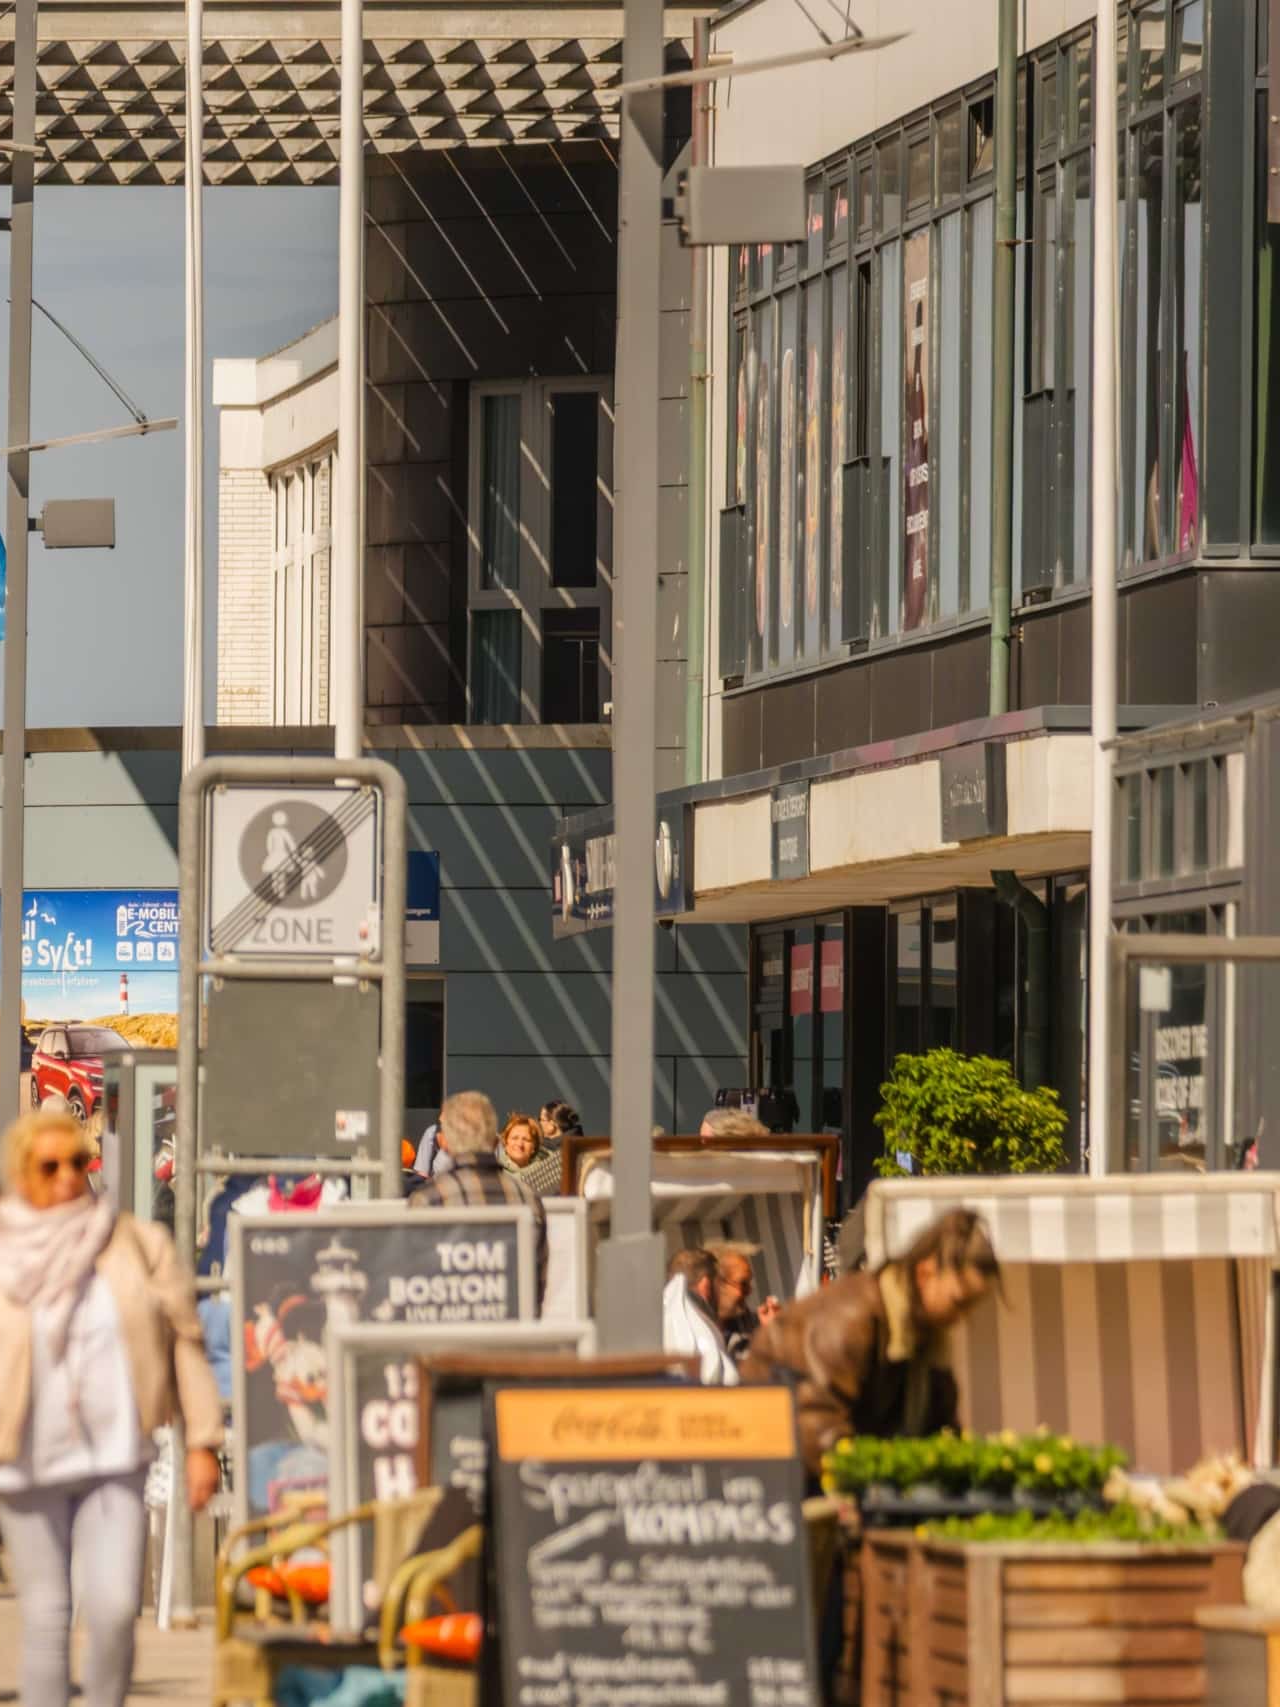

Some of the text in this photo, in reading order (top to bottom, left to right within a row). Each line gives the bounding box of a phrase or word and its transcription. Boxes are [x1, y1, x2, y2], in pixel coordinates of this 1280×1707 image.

[149, 921, 179, 933] CENT
[252, 917, 334, 945] ZONE
[37, 932, 92, 971] Sylt!
[436, 1242, 506, 1272] TOM
[389, 1275, 507, 1306] BOSTON
